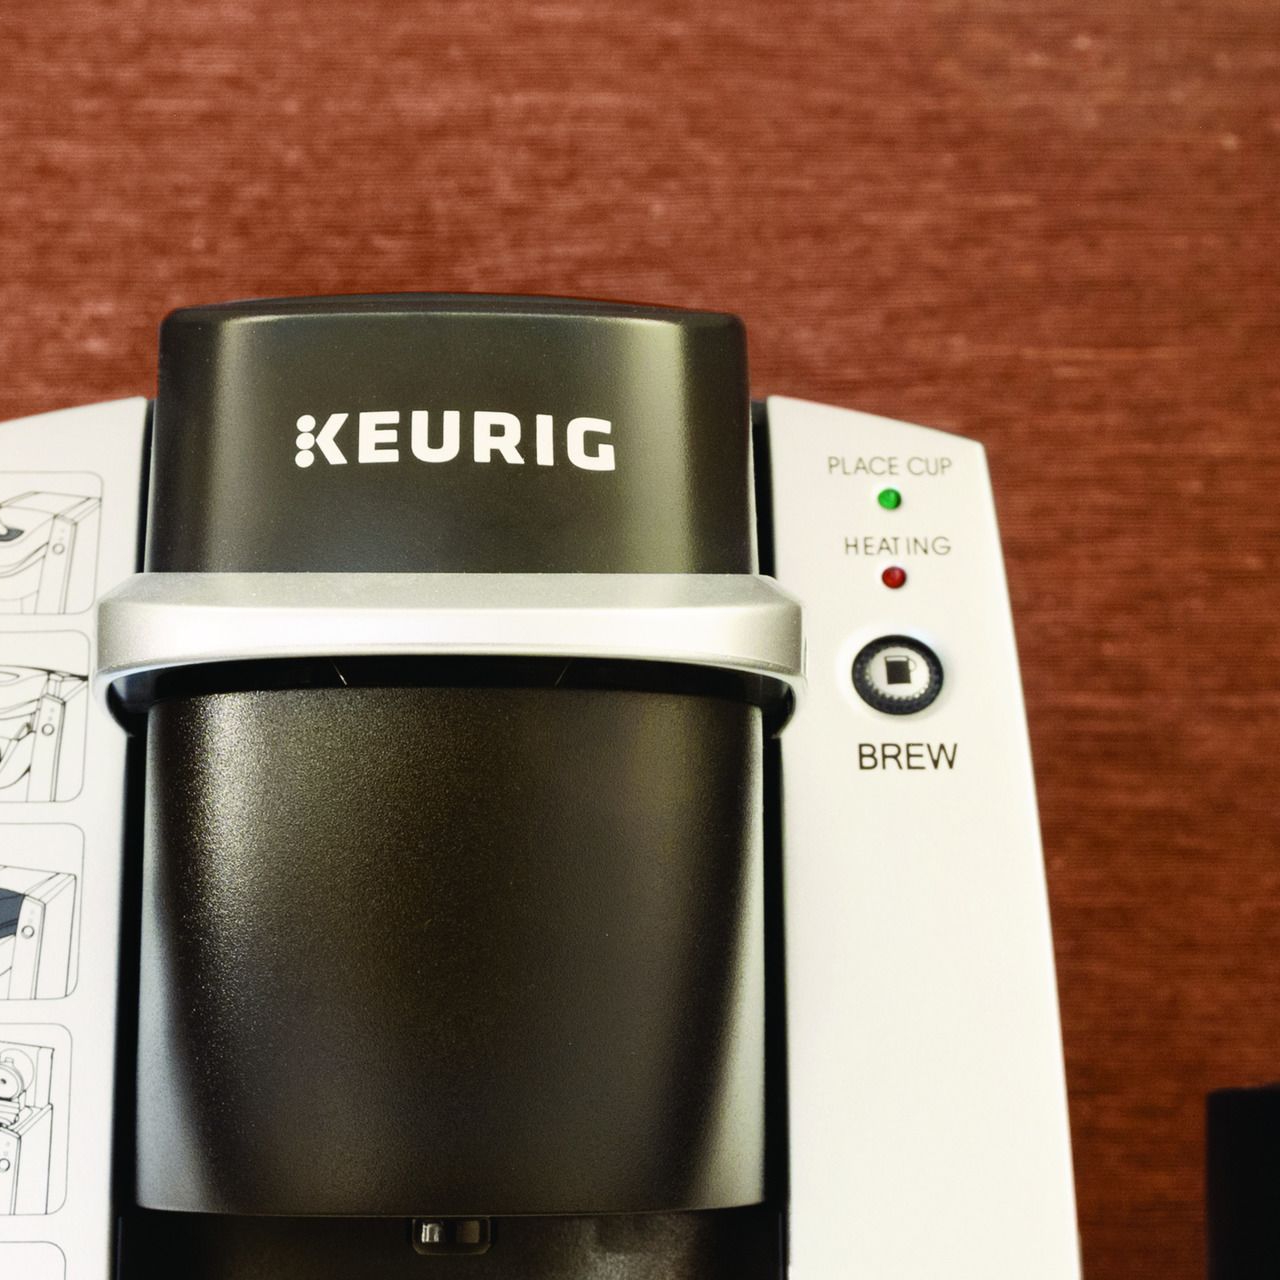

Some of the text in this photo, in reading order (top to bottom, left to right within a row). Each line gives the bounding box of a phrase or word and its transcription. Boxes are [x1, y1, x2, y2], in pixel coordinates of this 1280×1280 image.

[295, 410, 616, 472] KEURIG
[827, 456, 953, 476] PLACE CUP
[844, 536, 952, 556] HEATING
[858, 743, 958, 771] BREW
